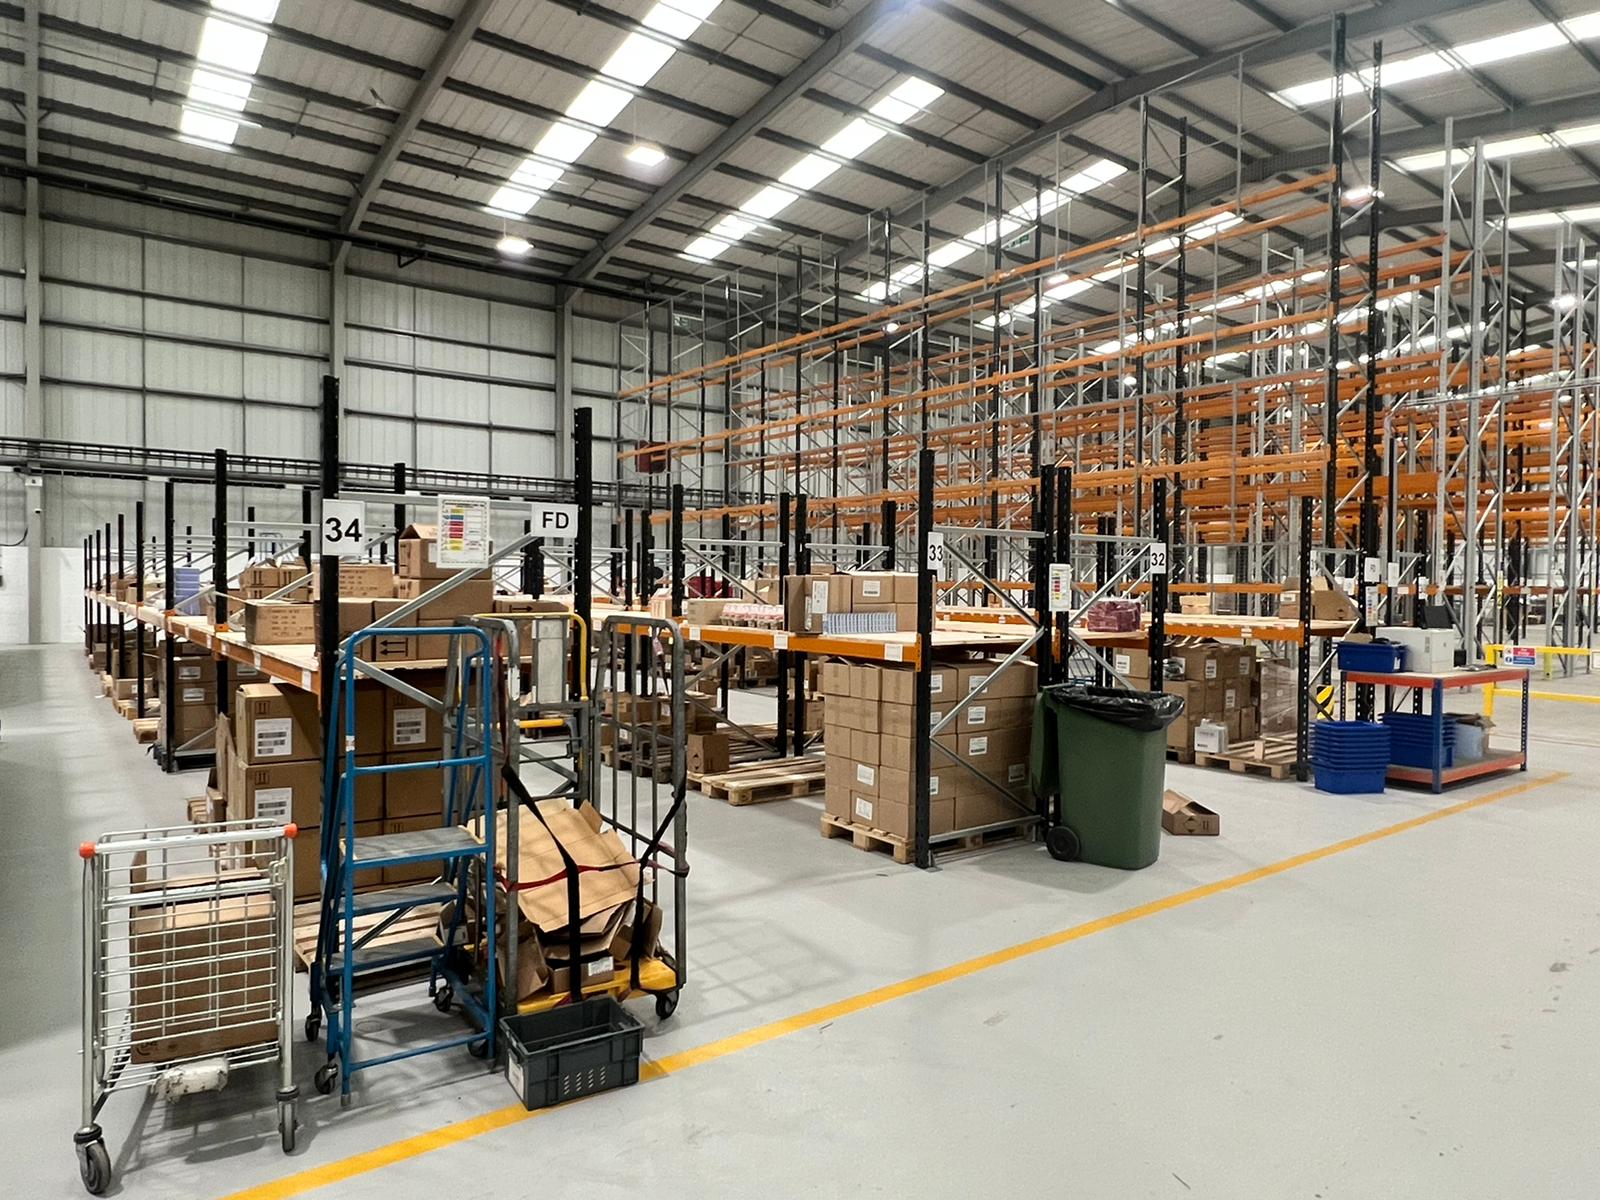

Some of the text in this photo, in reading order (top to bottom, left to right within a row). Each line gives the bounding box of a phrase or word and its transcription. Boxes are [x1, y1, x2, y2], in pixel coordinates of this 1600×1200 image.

[542, 511, 570, 529] FD
[325, 517, 363, 543] 34
[929, 544, 943, 562] 33
[1151, 552, 1165, 567] 32
